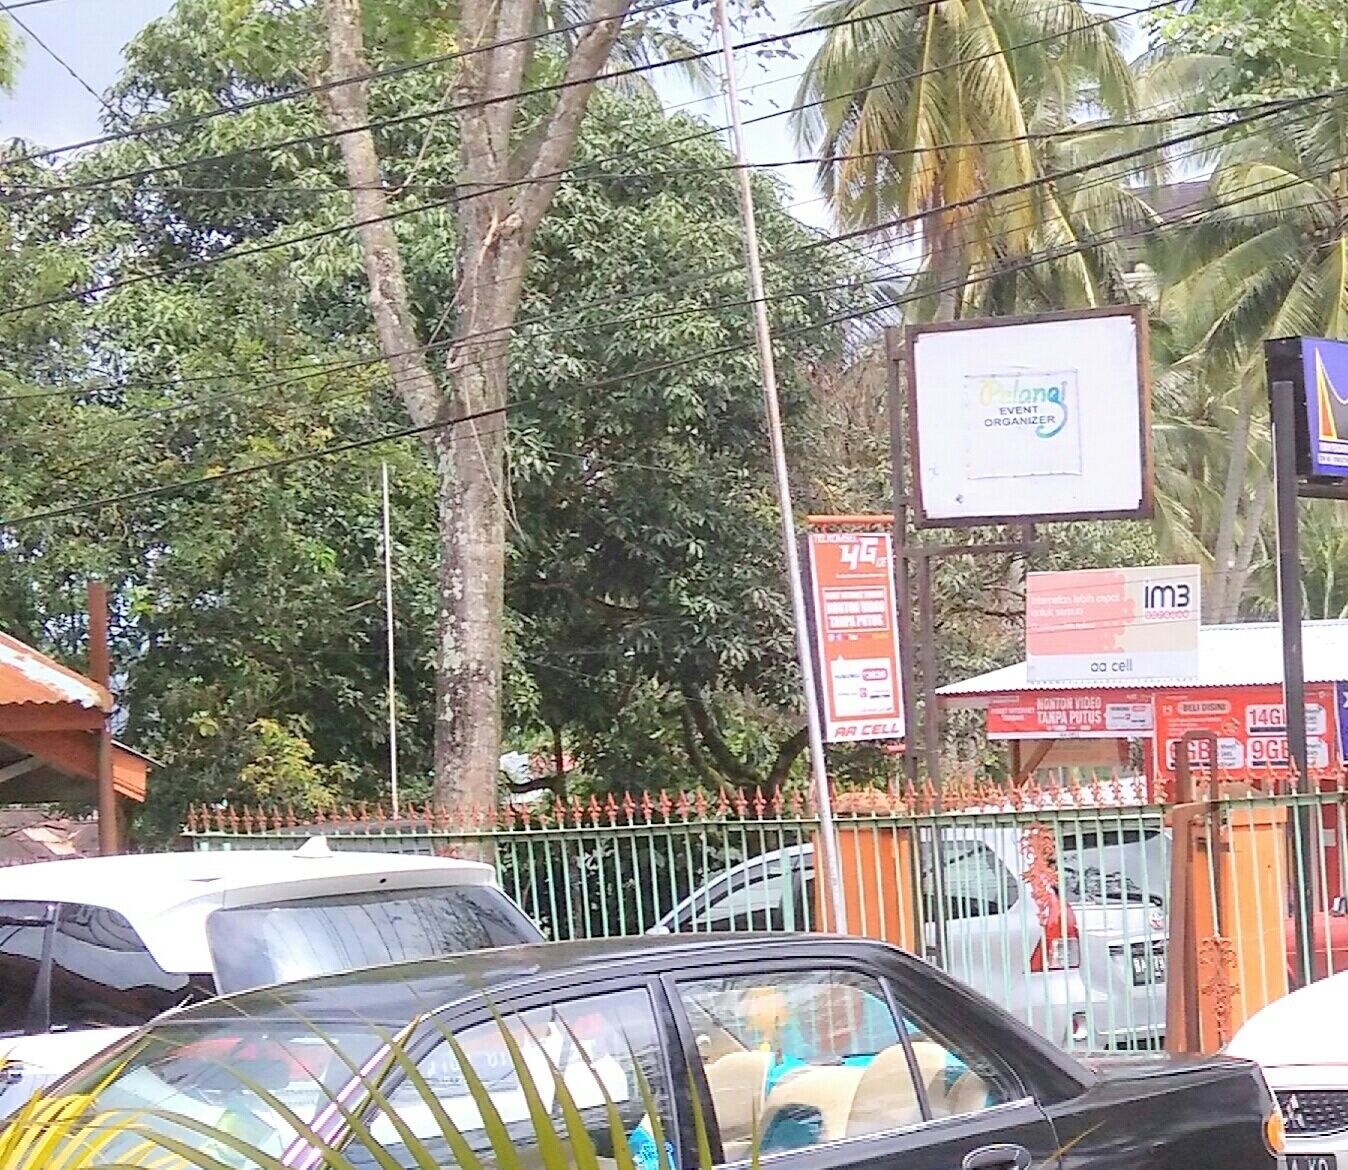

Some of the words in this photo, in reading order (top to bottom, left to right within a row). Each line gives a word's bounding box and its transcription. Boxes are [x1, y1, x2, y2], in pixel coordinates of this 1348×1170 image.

[1000, 405, 1039, 416] EVENT
[984, 415, 1056, 427] ORGANIZER
[1091, 662, 1107, 673] aa
[1111, 658, 1133, 673] cell
[1074, 696, 1102, 710] VIDEO
[1037, 710, 1068, 725] TANPA
[1069, 709, 1102, 724] PUTUS
[1250, 708, 1287, 726] 14G
[834, 726, 857, 738] AA
[861, 722, 900, 736] CELL
